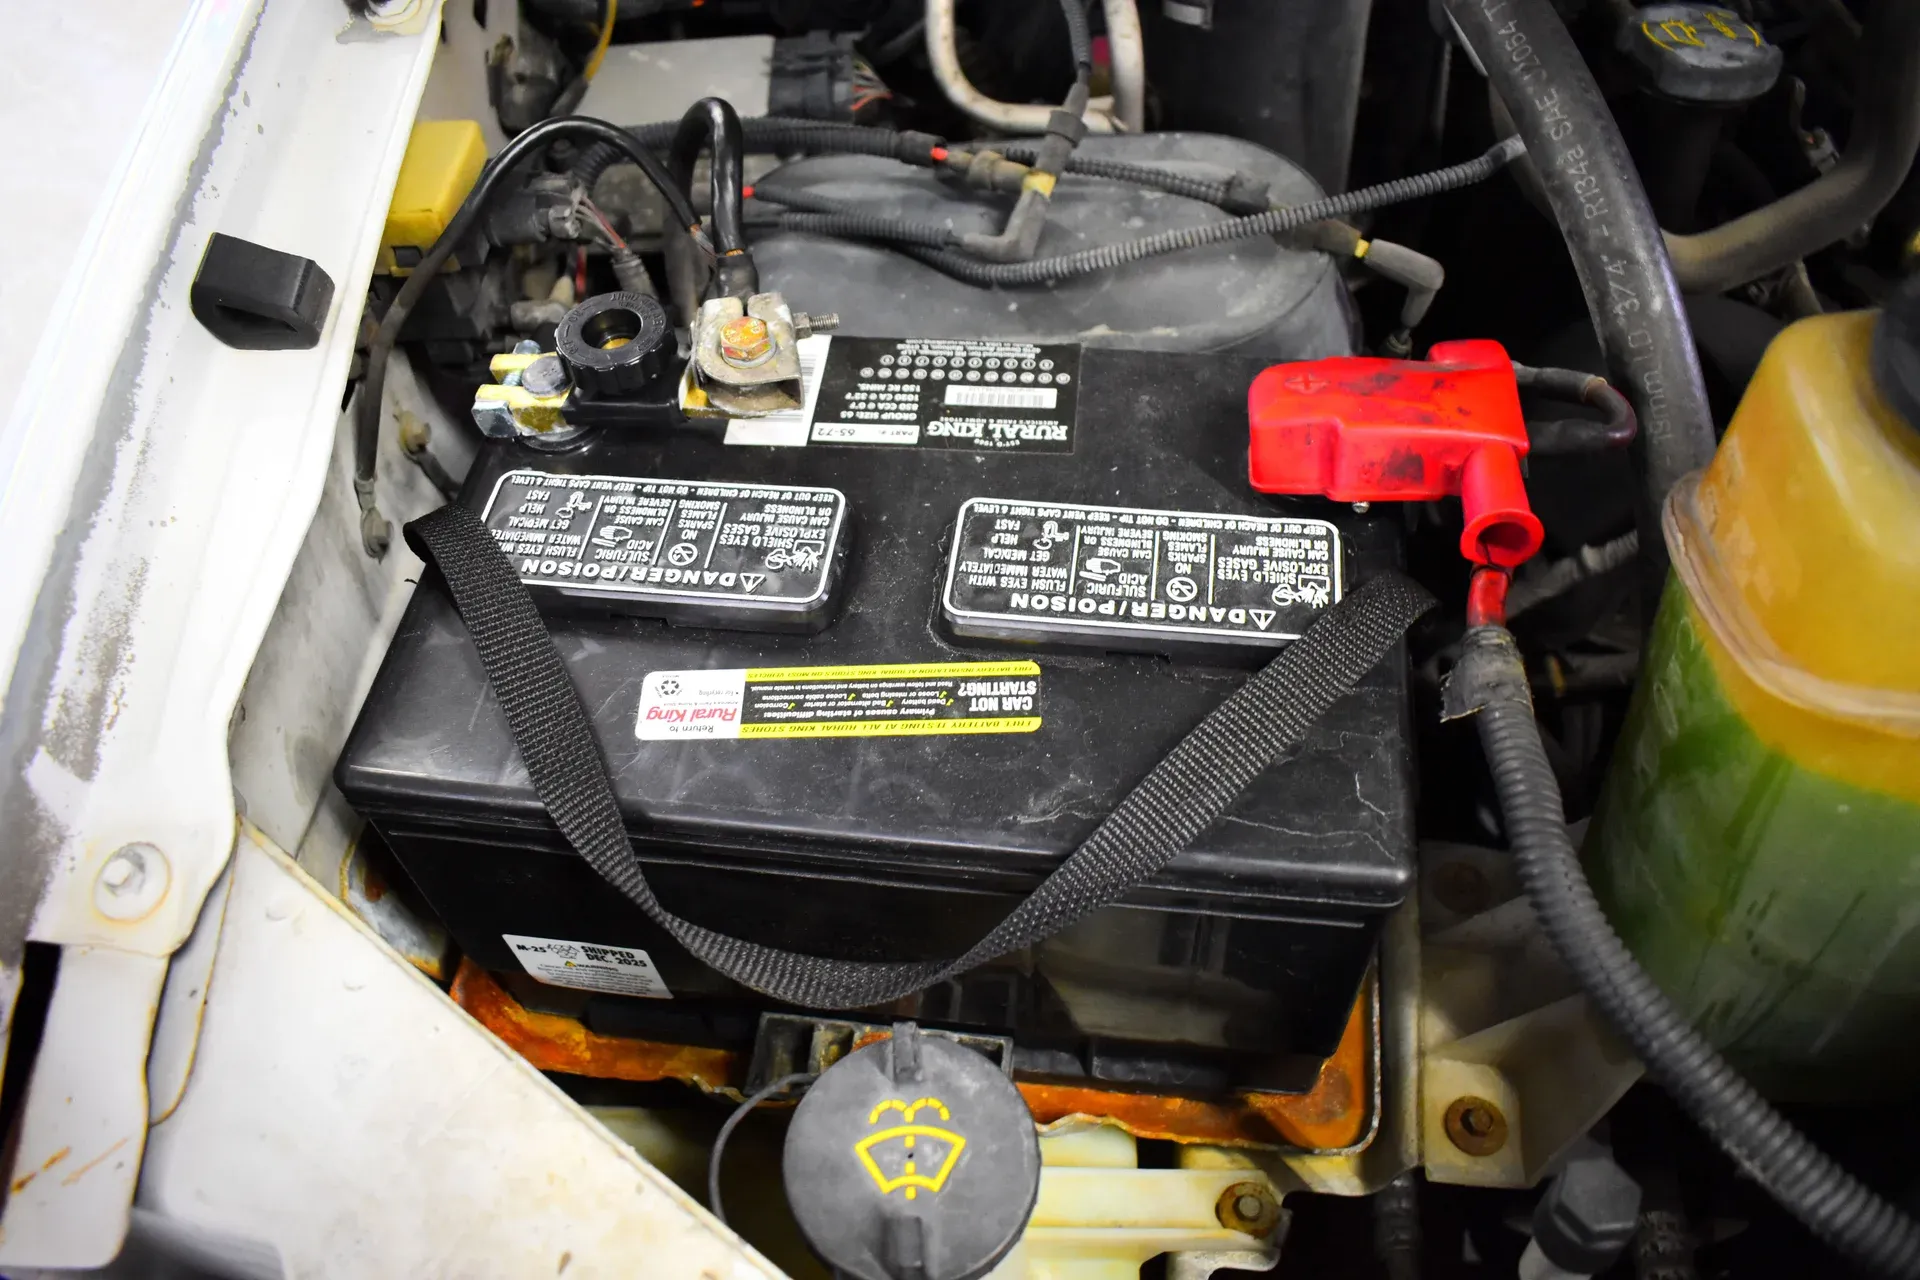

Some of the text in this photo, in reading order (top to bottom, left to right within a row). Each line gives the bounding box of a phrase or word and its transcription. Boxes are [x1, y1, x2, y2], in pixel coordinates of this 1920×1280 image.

[1535, 88, 1573, 141] SAE
[1562, 141, 1610, 218] R134a
[817, 427, 855, 436] 65-72
[927, 421, 1067, 440] RURAL KING
[525, 489, 550, 500] FAST
[603, 495, 671, 507] SEVERE INJURY
[518, 502, 546, 514] HELP
[603, 504, 667, 516] BLINDNESS OR
[678, 499, 720, 510] SMOKING
[764, 503, 832, 516] OR BLINDNESS
[613, 514, 664, 526] CAN CAUSE
[680, 509, 717, 519] FLAMES
[739, 512, 829, 526] CAN CAUSE INJURY
[508, 516, 570, 529] GET MEDICAL
[677, 518, 714, 529] SPARKS
[994, 518, 1020, 530] FAST
[681, 528, 698, 539] NO
[722, 523, 825, 539] EXPLOSIVE GASES
[1080, 525, 1153, 539] SEVERE INJURY
[1162, 530, 1207, 542] SMOKING
[548, 533, 581, 545] WATER
[626, 539, 654, 550] ACID
[719, 533, 793, 548] SHIELD EYES
[990, 532, 1018, 545] HELP
[1083, 535, 1152, 549] BLINDNESS OR
[1255, 536, 1328, 550] OR BLINDNESS
[516, 543, 577, 557] FLUSH EYES
[1097, 546, 1152, 559] CAN CAUSE
[1167, 541, 1207, 553] FLAMES
[1232, 544, 1328, 561] CAN CAUSE INJURY
[594, 548, 650, 561] SULFURIC
[983, 547, 1050, 562] GET MEDICAL
[1167, 551, 1206, 563] SPARKS
[959, 560, 1067, 578] WATER IMMEDIATELY
[1174, 562, 1191, 574] NO
[1217, 556, 1328, 575] EXPLOSIVE GASES
[522, 559, 735, 586] DANGER/POISON
[1118, 572, 1147, 585] ACID
[1217, 567, 1296, 585] SHIELD EYES
[968, 574, 1065, 591] FLUSH EYES WITH
[1086, 582, 1146, 597] SULFURIC
[1011, 593, 1245, 623] DANGER/POISON
[958, 681, 1036, 696] STARTING?
[969, 696, 1032, 711] CAR NOT
[646, 706, 736, 722] Rural King
[816, 709, 851, 717] starting
[853, 709, 863, 717] of
[899, 707, 935, 715] Primary
[682, 725, 713, 733] Return
[516, 944, 546, 952] M-25
[581, 945, 634, 958] SHIPPED
[585, 953, 647, 967] DEC. 2025
